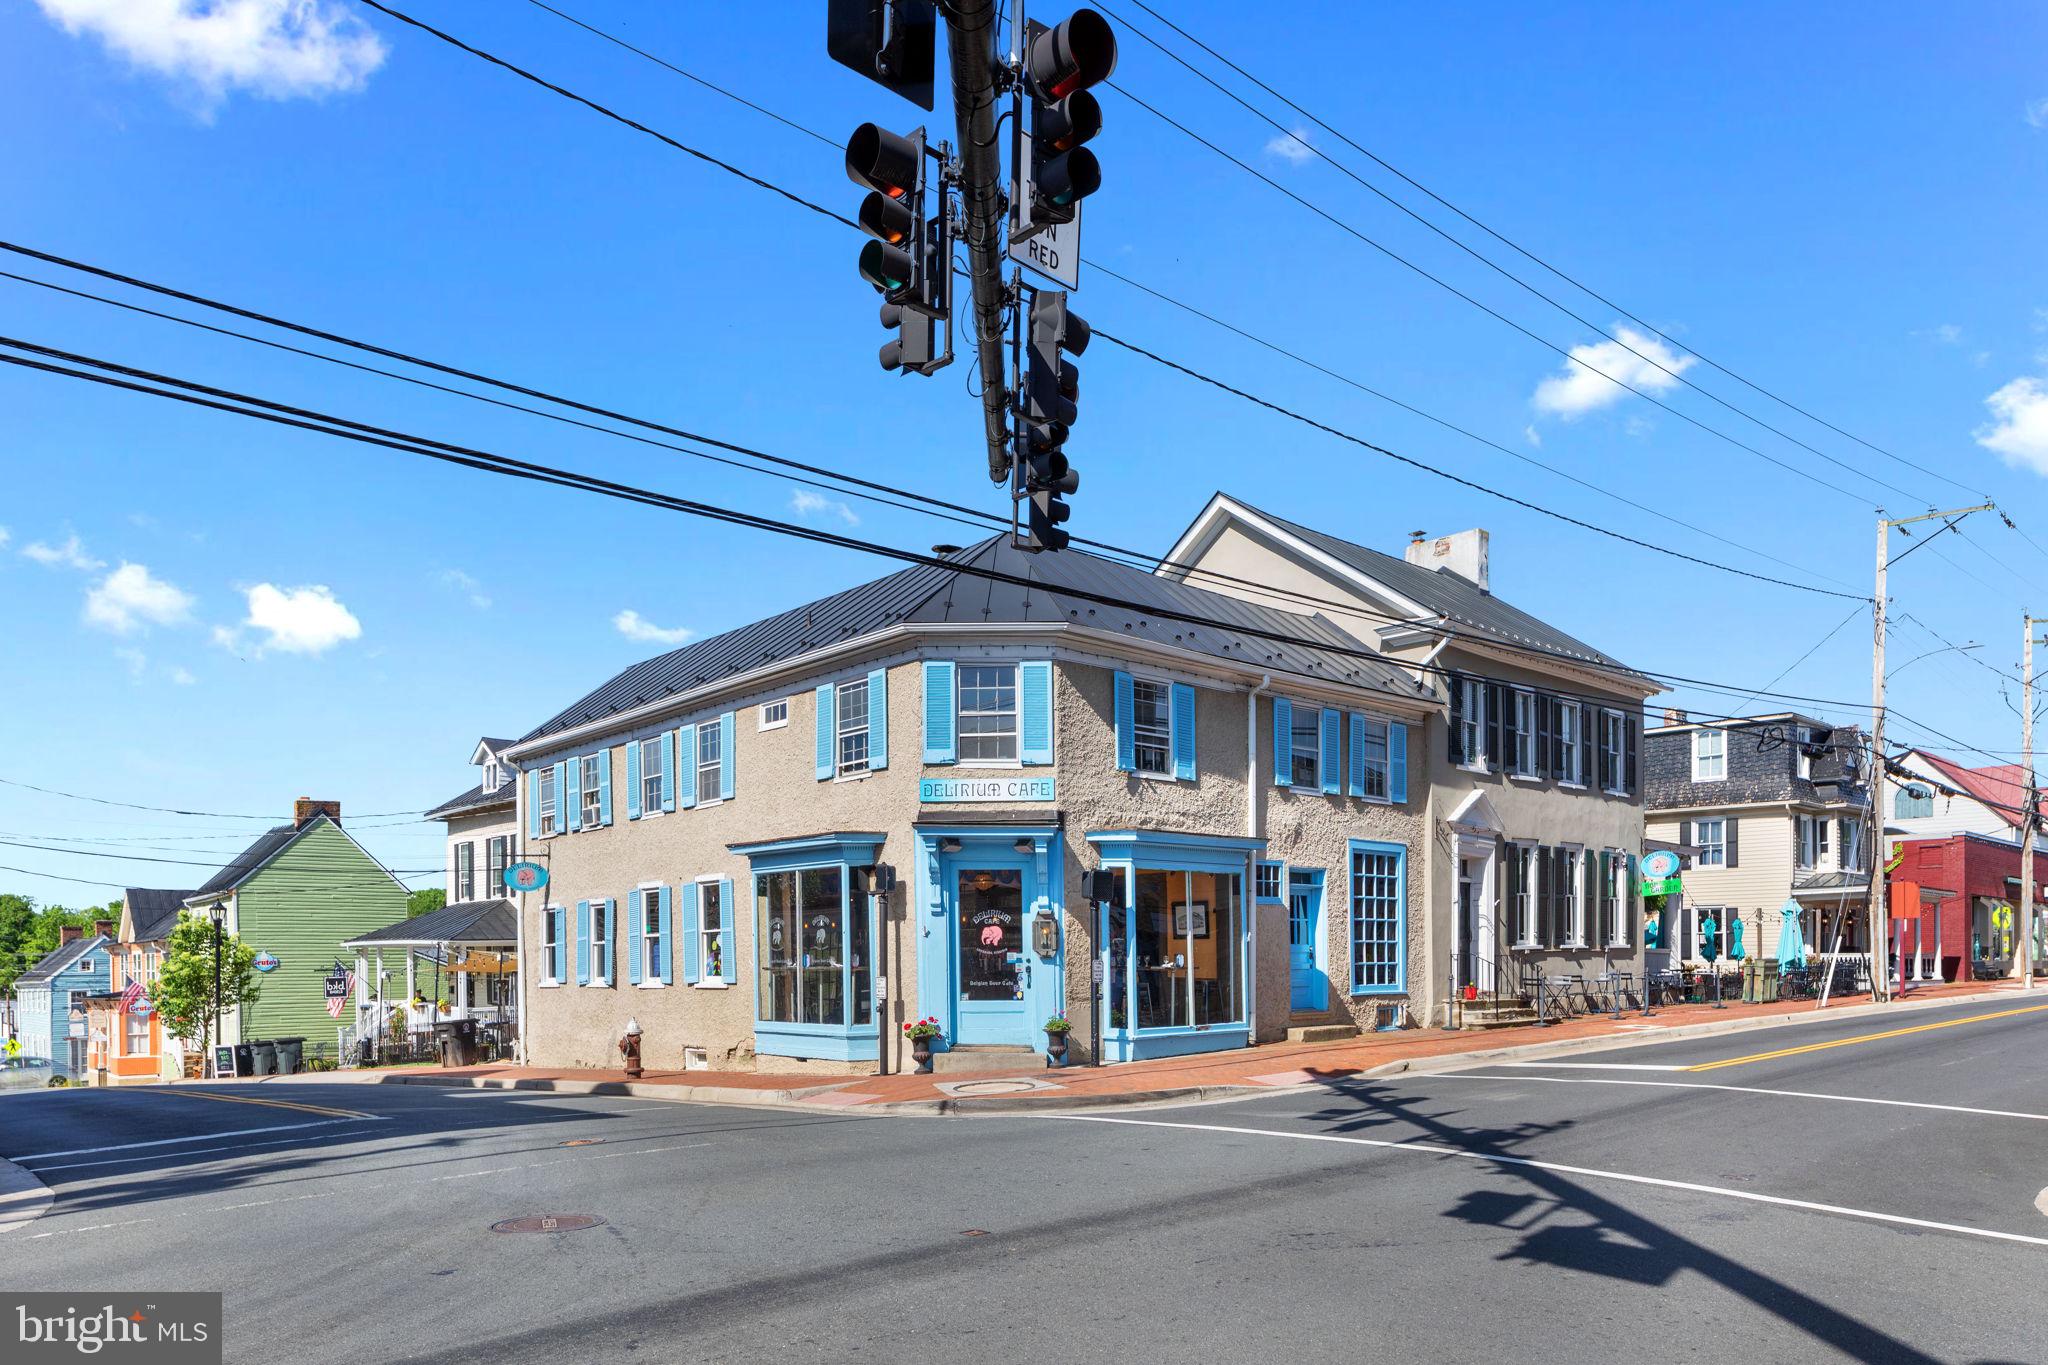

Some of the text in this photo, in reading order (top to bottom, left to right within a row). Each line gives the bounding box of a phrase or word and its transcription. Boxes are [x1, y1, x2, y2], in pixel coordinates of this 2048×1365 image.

[1029, 239, 1059, 269] RED
[923, 782, 1050, 797] DELIRIUM CAFE
[508, 863, 543, 873] DELIRIUM
[973, 910, 1011, 924] DELIRIUM
